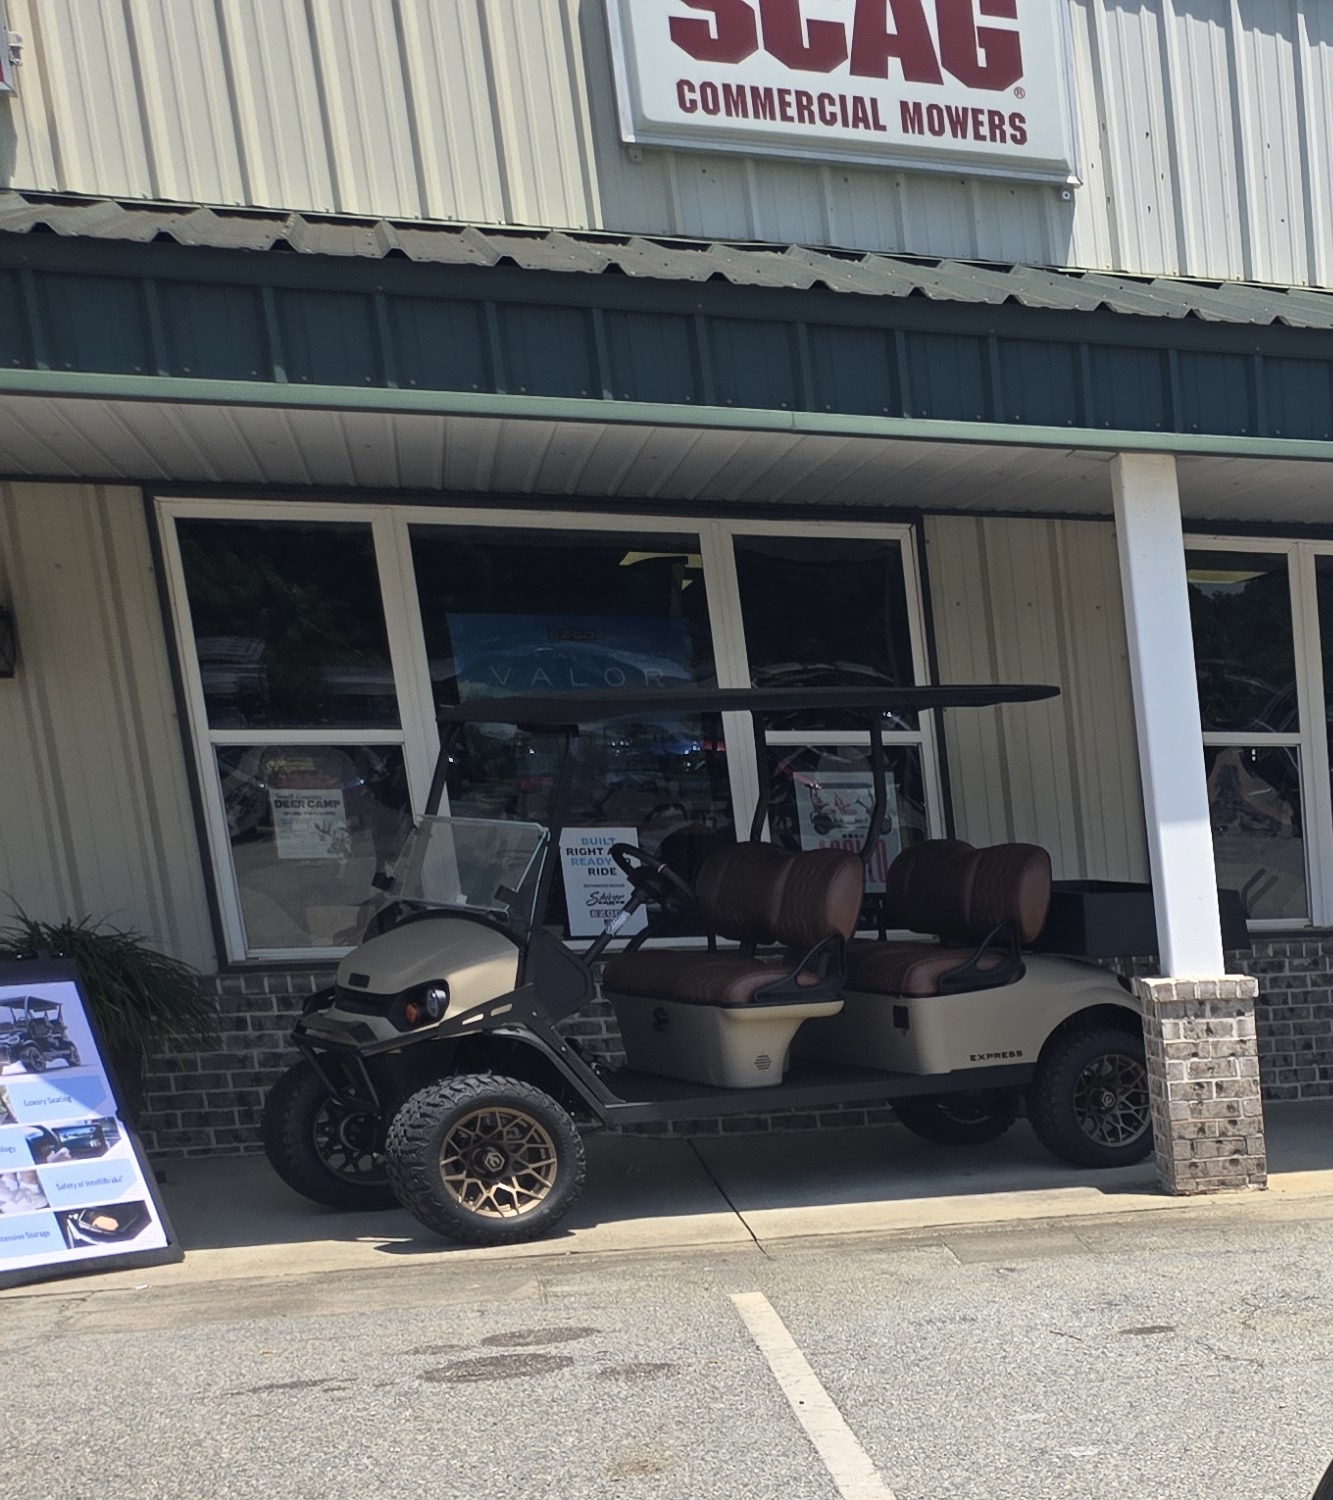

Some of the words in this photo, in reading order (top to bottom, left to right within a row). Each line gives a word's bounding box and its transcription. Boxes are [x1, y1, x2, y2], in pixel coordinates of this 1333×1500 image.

[676, 79, 887, 132] COMMERCIAL
[901, 100, 1028, 146] MOWERS
[490, 667, 666, 688] VALOR
[274, 800, 305, 808] DEER
[307, 800, 341, 808] CAMP
[581, 837, 617, 845] BUILT
[566, 848, 604, 856] RIGHT
[571, 857, 612, 866] READY
[588, 868, 618, 876] RIDE
[969, 1050, 1023, 1061] EXPRESS
[24, 1098, 47, 1107] Luxury
[56, 1181, 78, 1191] Safety
[25, 1230, 50, 1239] Storage
